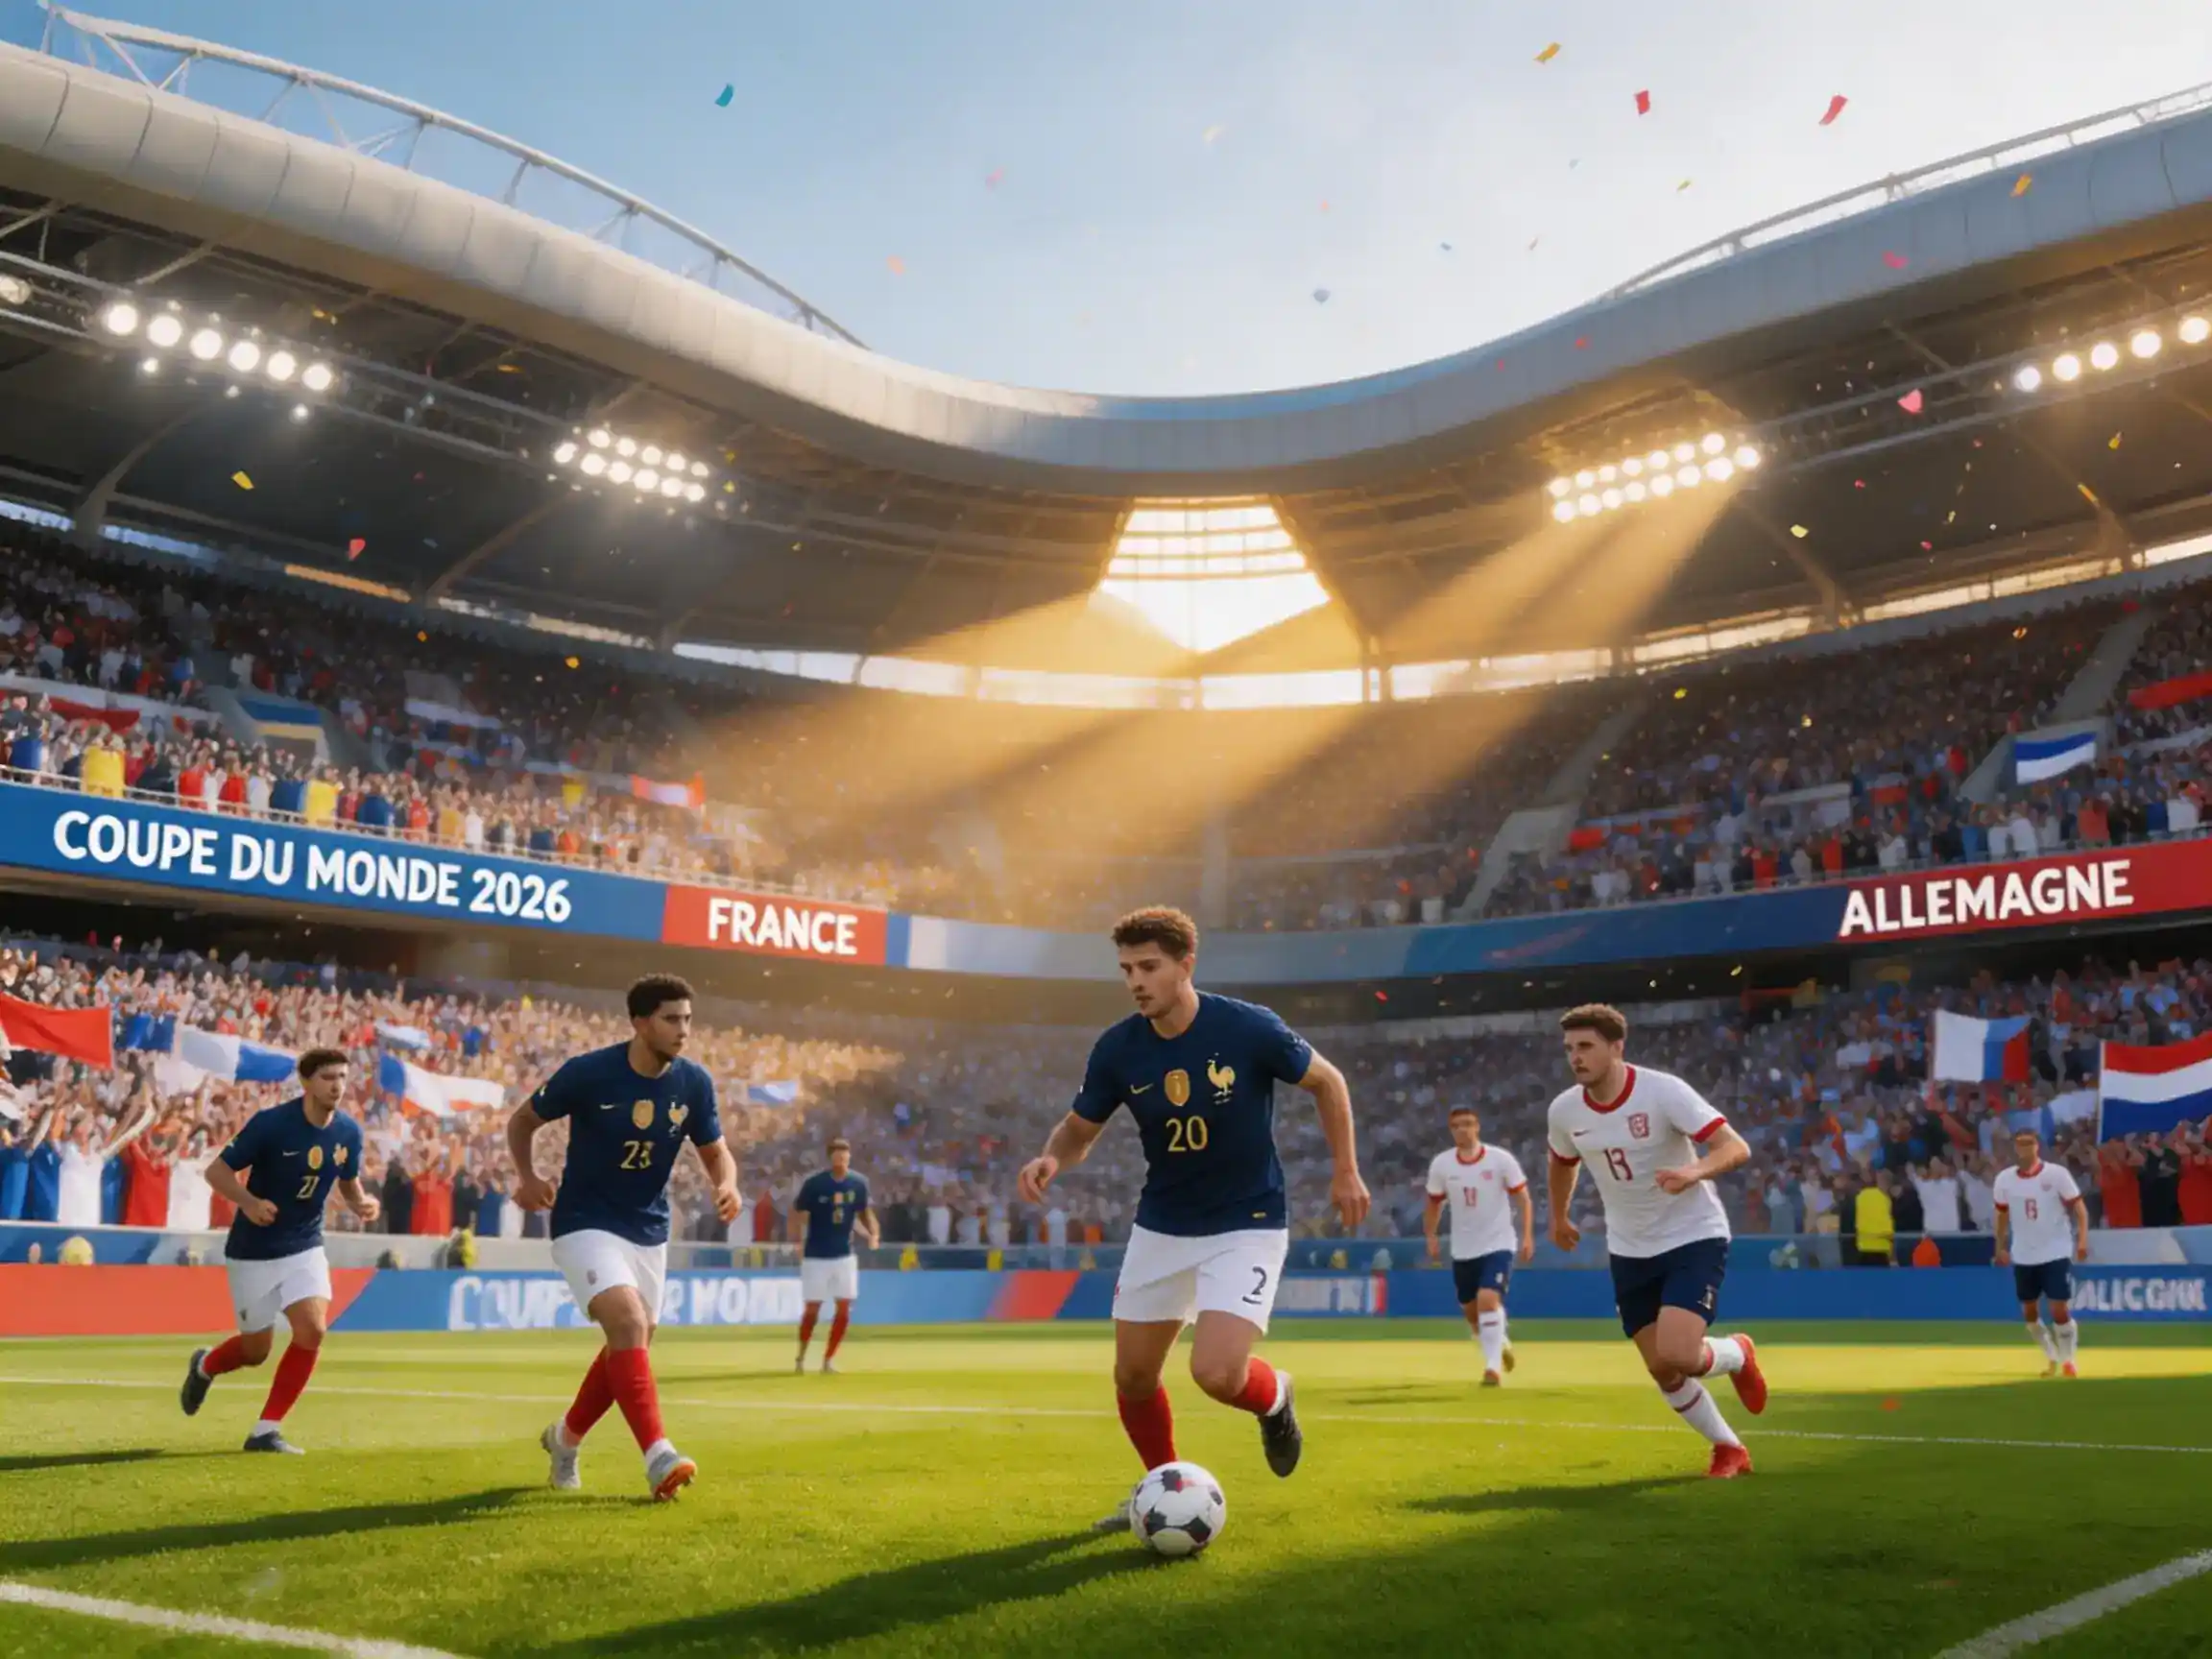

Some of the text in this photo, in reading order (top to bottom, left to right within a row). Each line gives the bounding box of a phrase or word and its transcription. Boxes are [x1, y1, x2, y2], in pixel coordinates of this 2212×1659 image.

[54, 810, 571, 923] COUPE DU MONDE 2026
[1839, 859, 2134, 937] ALLEMAGNE
[708, 896, 858, 955] FRANCE
[1166, 1115, 1208, 1151] 20
